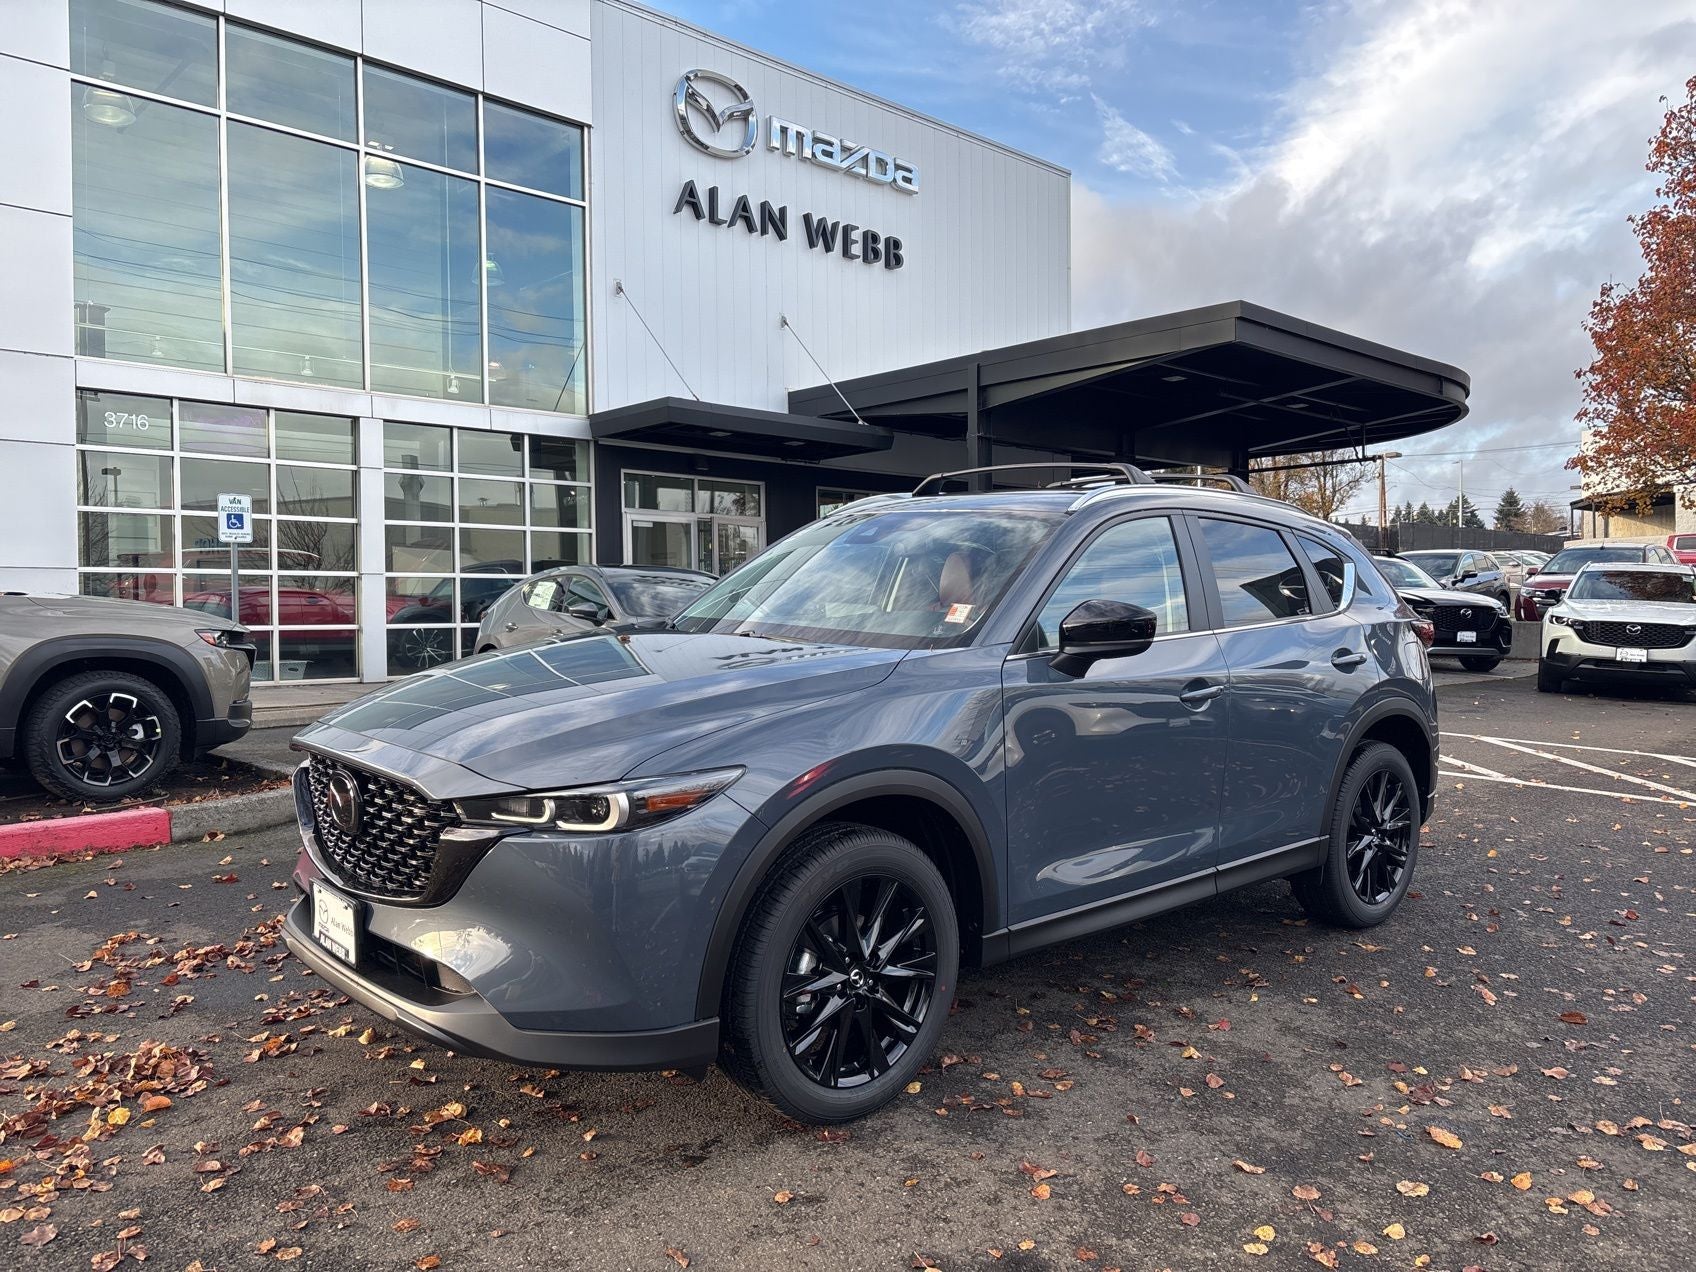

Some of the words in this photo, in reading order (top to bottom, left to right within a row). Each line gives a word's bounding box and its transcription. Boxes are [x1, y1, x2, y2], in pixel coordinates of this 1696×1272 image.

[766, 115, 920, 195] mazda
[673, 179, 788, 241] ALAN
[802, 212, 904, 270] WEBB
[104, 411, 149, 430] 3716
[220, 505, 250, 513] ACCESSIBLE
[228, 497, 242, 505] VAN
